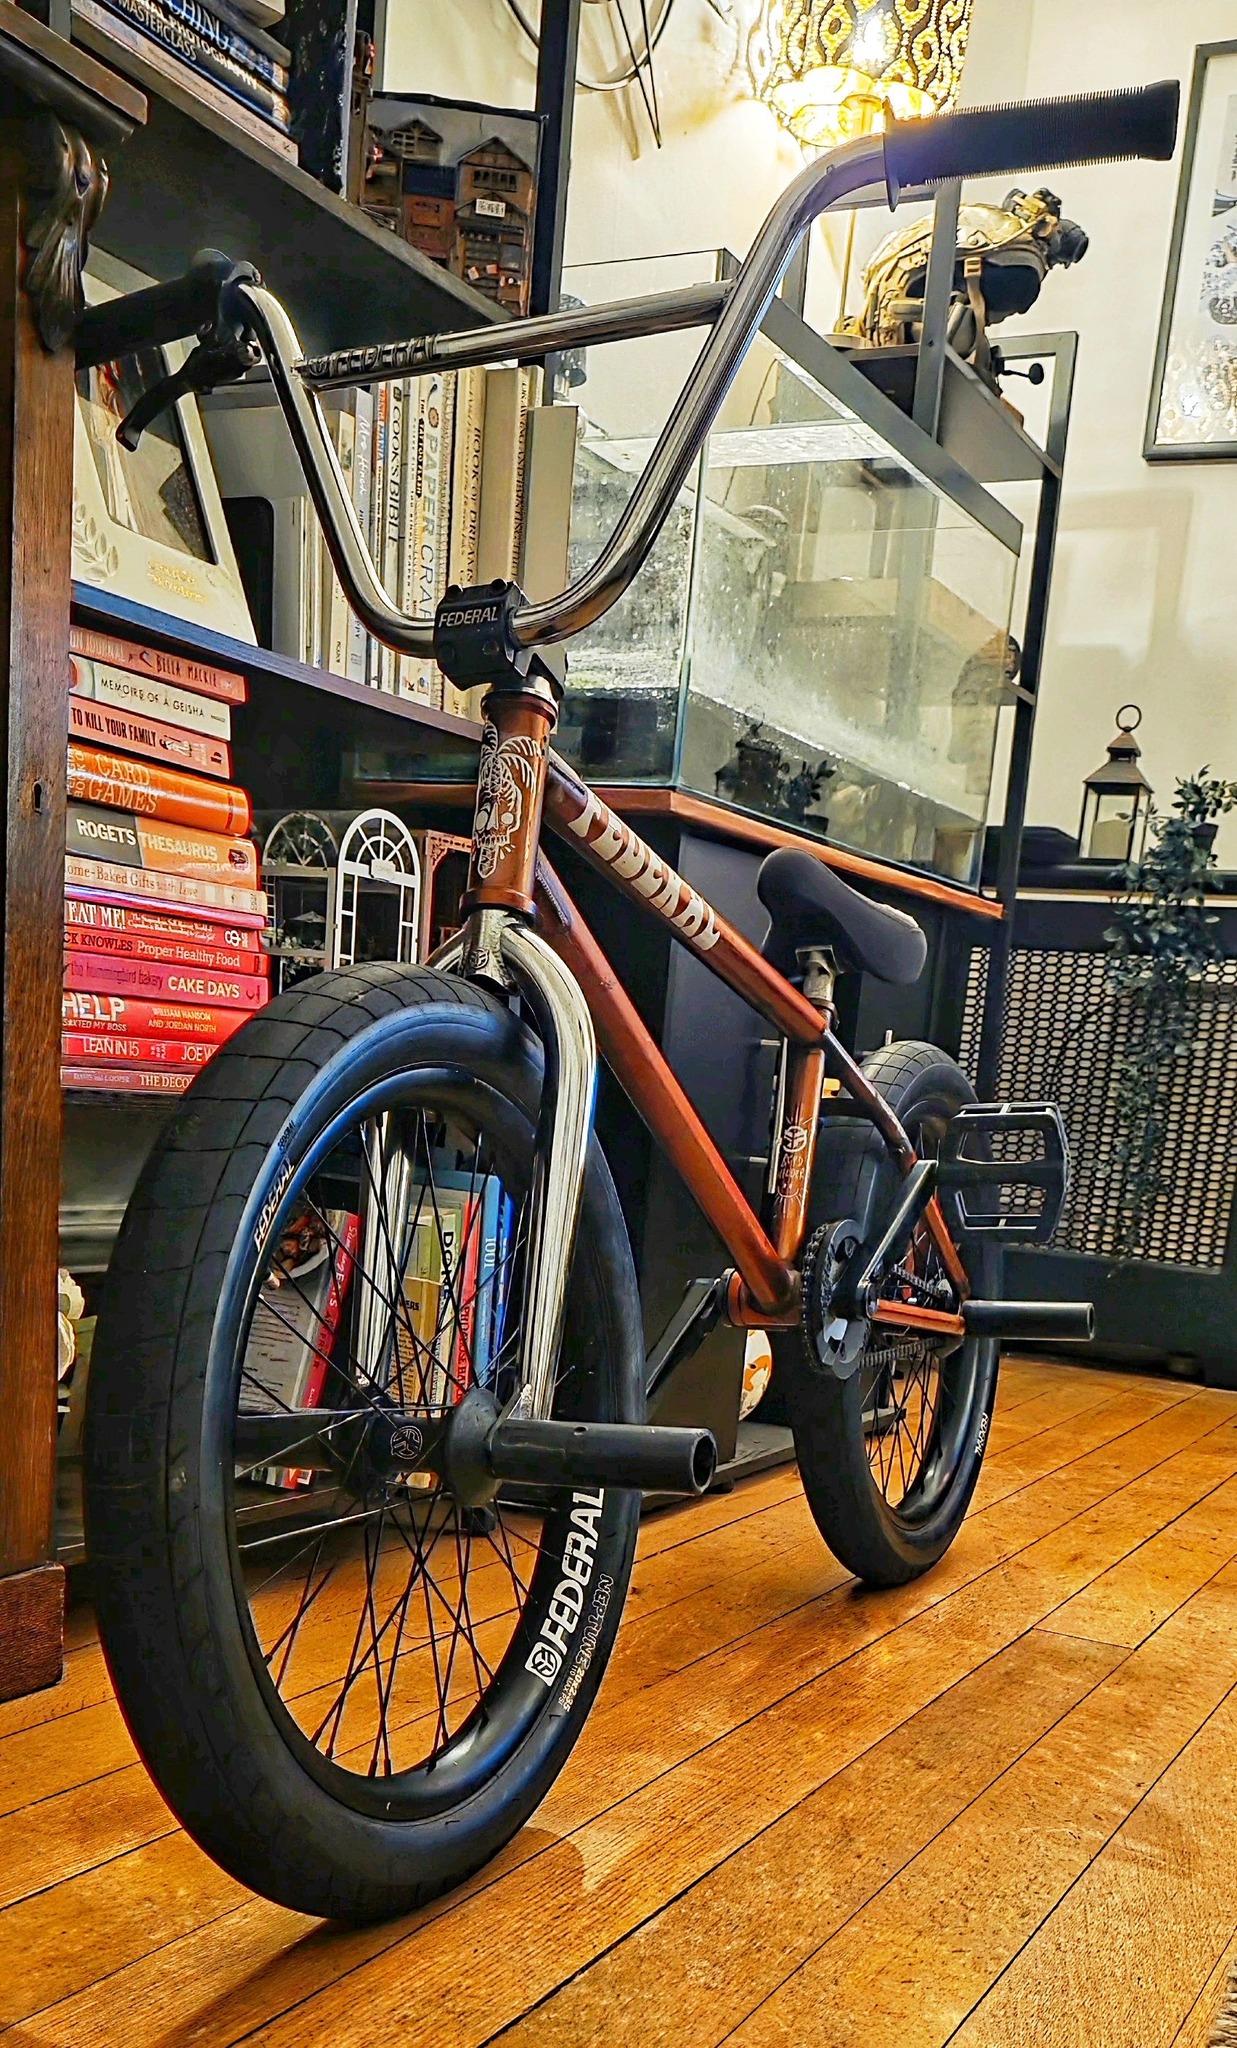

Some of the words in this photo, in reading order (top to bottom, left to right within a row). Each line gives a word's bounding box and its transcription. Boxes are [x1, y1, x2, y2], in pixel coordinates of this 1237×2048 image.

[117, 1, 196, 61] MASTERCLASS
[422, 432, 440, 538] PAPER
[438, 606, 499, 629] FEDERAL
[155, 654, 180, 678] BELLA
[187, 662, 217, 688] MACKIE
[100, 677, 143, 700] MEMOIRS
[147, 692, 159, 704] OF
[163, 695, 170, 707] A
[172, 700, 205, 718] GEISHA
[71, 706, 84, 725] TO
[84, 711, 103, 733] KILL
[105, 716, 128, 740] YOUR
[128, 724, 157, 748] FAMILY
[94, 753, 151, 786] CARD
[88, 775, 159, 814] GAMES
[76, 818, 137, 846] ROGETS
[138, 831, 218, 862] THESAURUS
[130, 870, 155, 891] Gifts
[567, 795, 721, 951] FEDERAL
[66, 900, 98, 926] EAT
[99, 904, 126, 930] ME!
[80, 933, 133, 952] KNOWLES
[137, 941, 175, 959] Proper
[176, 946, 214, 967] Healthy
[215, 952, 241, 968] Food
[168, 975, 205, 994] CAKE
[206, 980, 241, 999] DAYS
[62, 991, 126, 1022] HELP
[152, 1007, 185, 1019] WILLIAM
[185, 1009, 212, 1021] HANSON
[92, 1020, 107, 1031] MY
[106, 1022, 128, 1033] BOSS
[148, 1020, 164, 1030] AND
[164, 1022, 194, 1032] JORDAN
[82, 1037, 116, 1054] LEAN
[115, 1039, 128, 1055] IN
[129, 1040, 140, 1056] 15
[181, 1045, 204, 1061] JOE
[139, 1074, 162, 1088] THE
[253, 1157, 297, 1246] FEDERAL
[483, 1236, 497, 1270] 1001
[539, 1487, 605, 1656] FEDERAL
[575, 1573, 614, 1671] NEPTUNE
[563, 1677, 575, 1695] MAX
[568, 1663, 578, 1677] 110
[557, 1693, 569, 1707] PSI
[562, 1668, 586, 1713] 20x2.35
